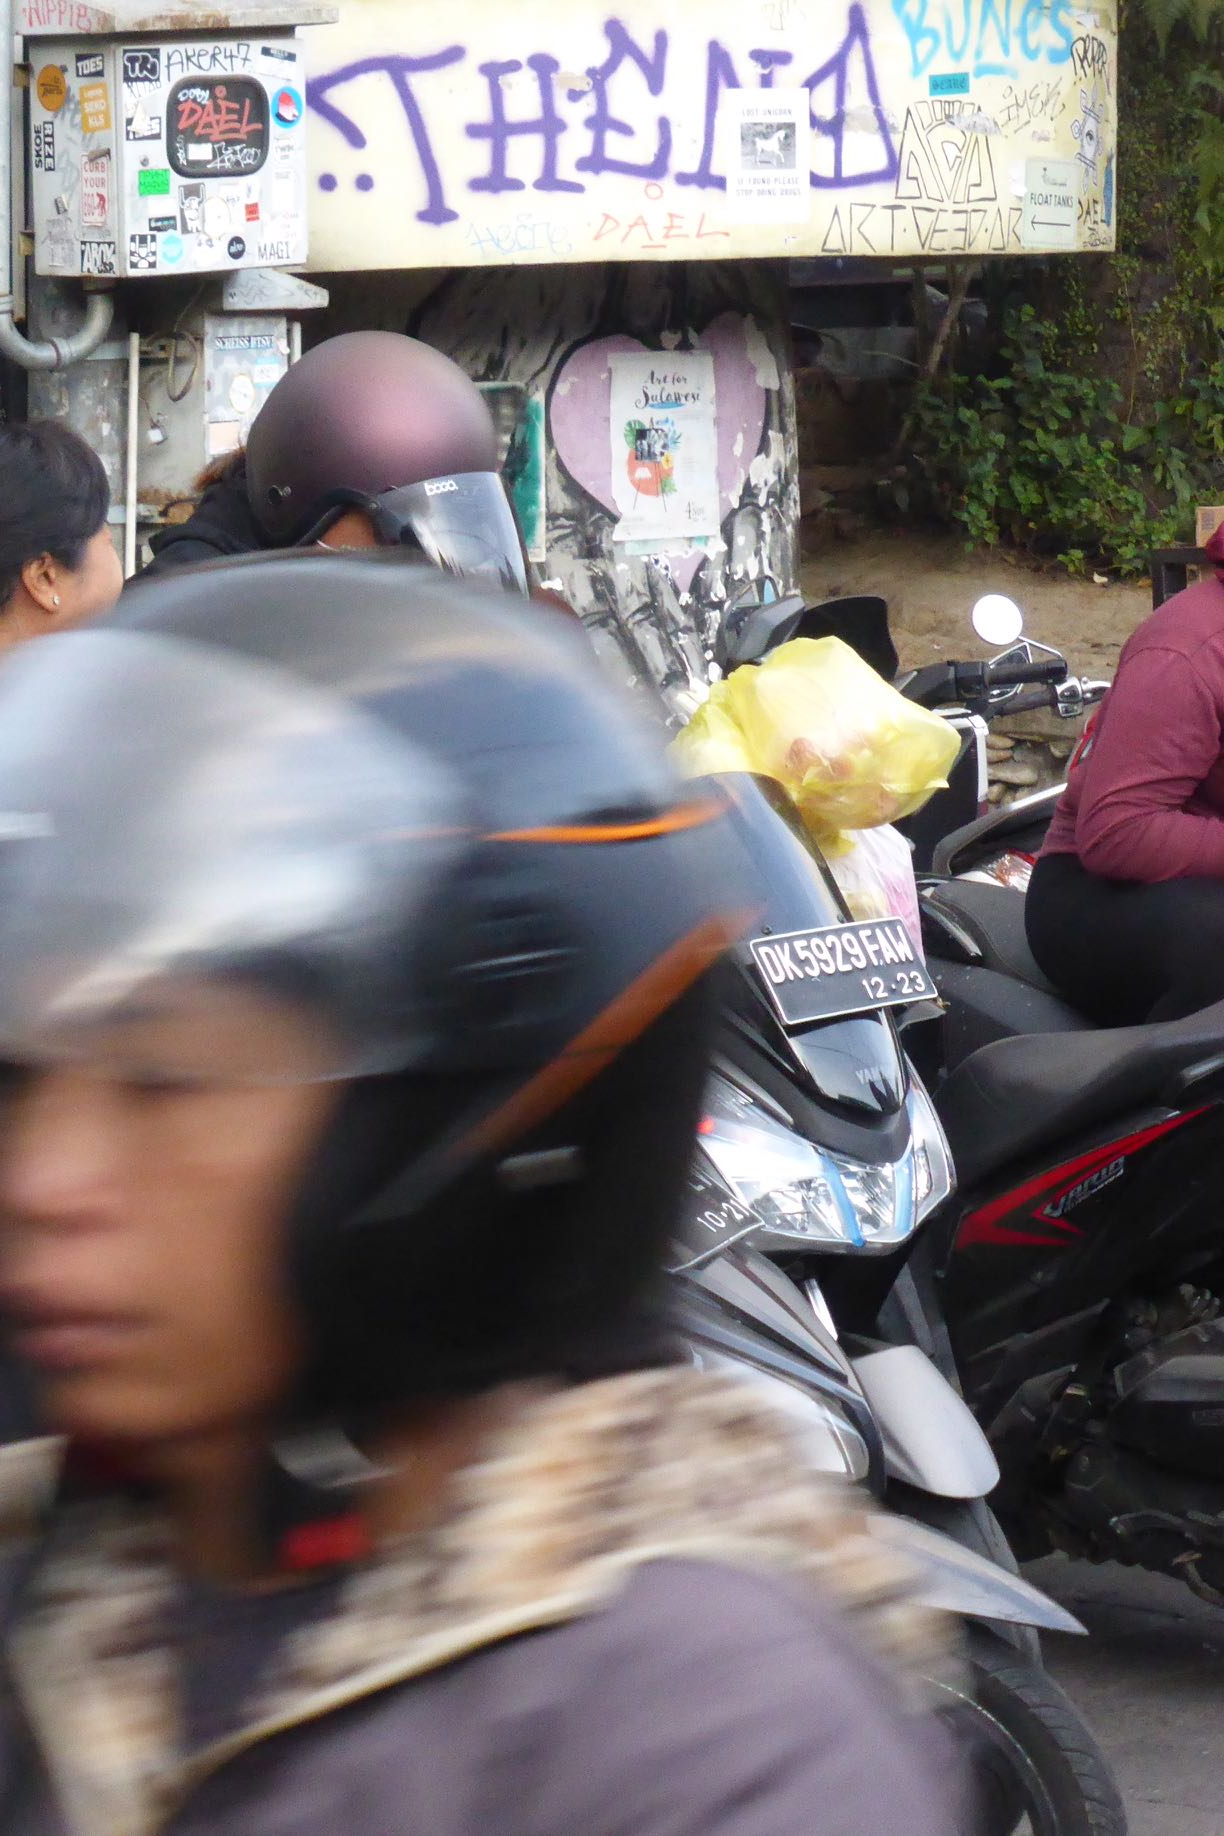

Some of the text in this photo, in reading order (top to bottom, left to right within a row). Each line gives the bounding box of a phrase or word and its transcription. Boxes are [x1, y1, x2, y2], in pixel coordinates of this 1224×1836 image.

[44, 122, 55, 171] RIZE
[83, 160, 106, 173] CURB
[83, 177, 106, 189] YOUR
[1030, 193, 1074, 208] FLOAT TANKS
